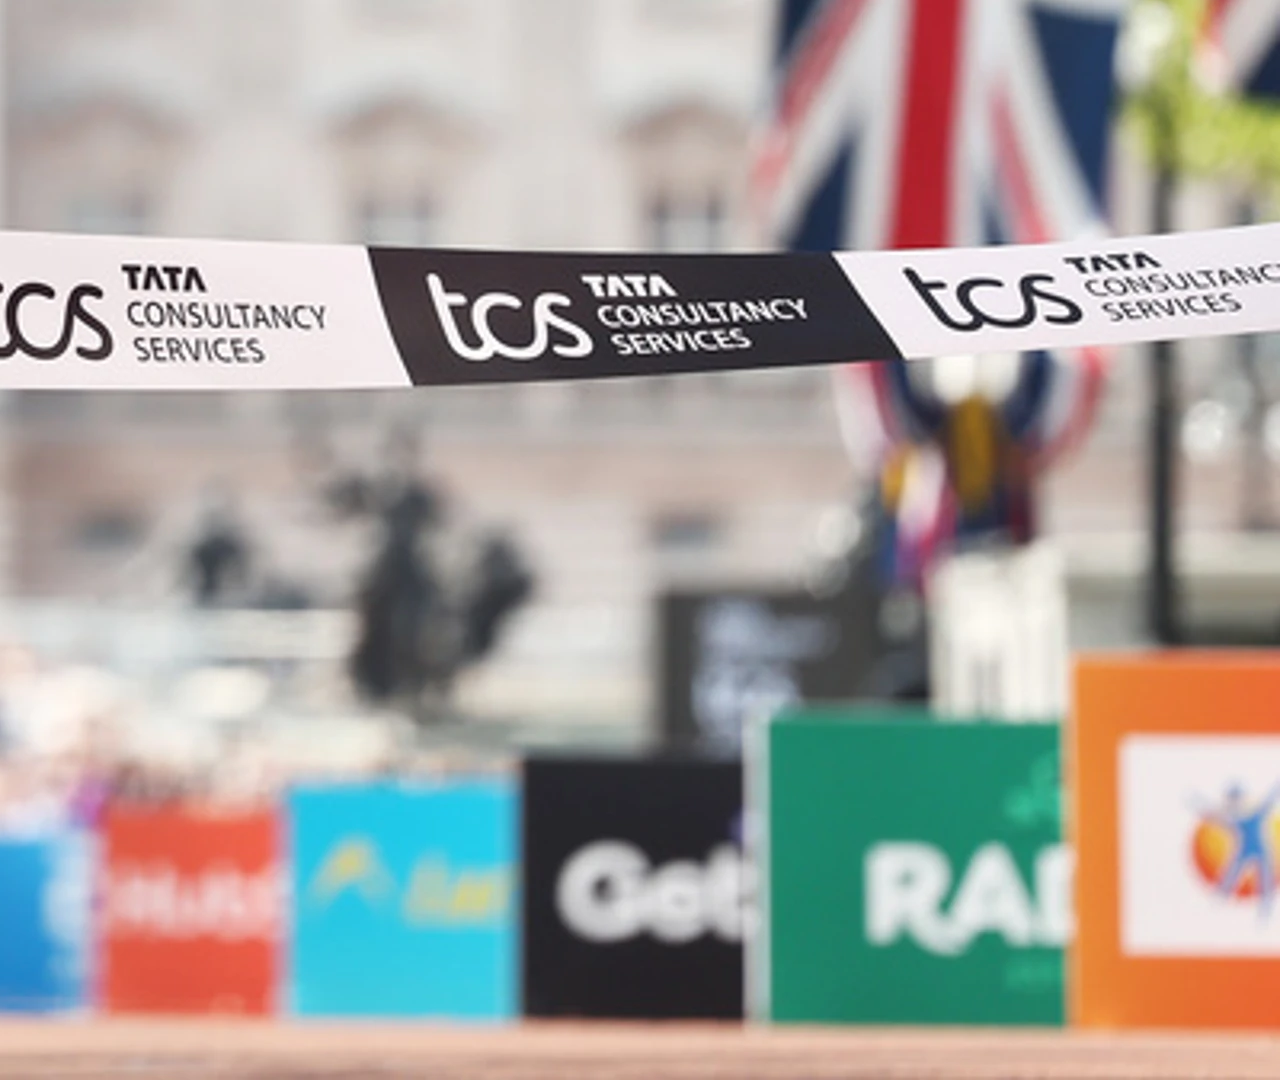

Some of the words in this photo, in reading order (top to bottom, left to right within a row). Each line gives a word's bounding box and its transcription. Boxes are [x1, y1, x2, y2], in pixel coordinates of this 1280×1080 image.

[1063, 251, 1163, 275] TATA
[121, 264, 207, 293] TATA
[581, 274, 679, 298] TATA
[597, 297, 809, 329] CONSULTANCY
[903, 267, 1083, 332] tcs
[1102, 292, 1243, 323] SERVICES
[126, 301, 327, 331] CONSULTANCY
[425, 272, 594, 361] tcs
[133, 336, 266, 364] SERVICES
[611, 327, 752, 356] SERVICES
